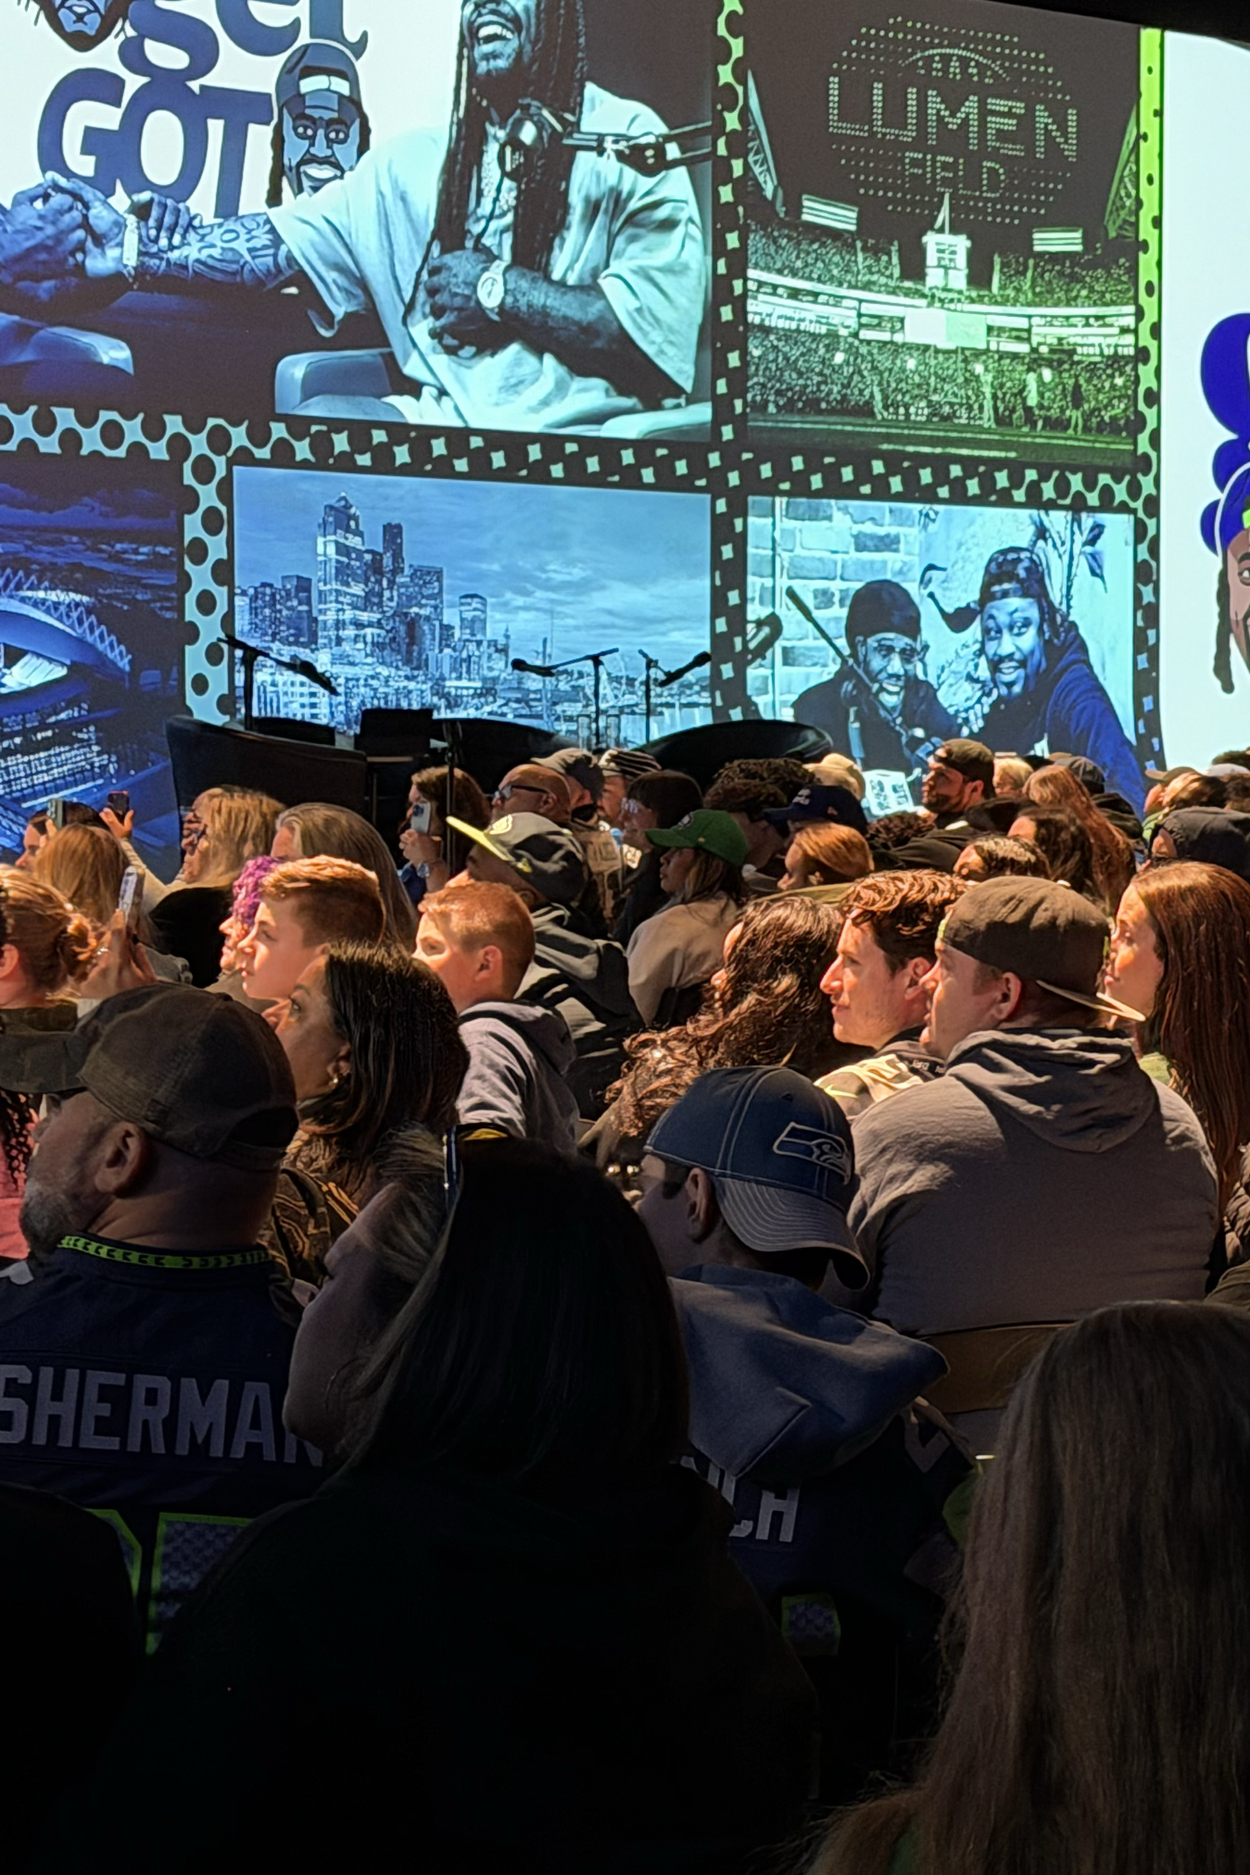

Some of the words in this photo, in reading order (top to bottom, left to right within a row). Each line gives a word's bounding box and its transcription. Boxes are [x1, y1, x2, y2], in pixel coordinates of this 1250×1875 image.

[37, 66, 273, 219] GOT
[828, 75, 1077, 163] LUMEN
[904, 150, 1006, 198] FIELD
